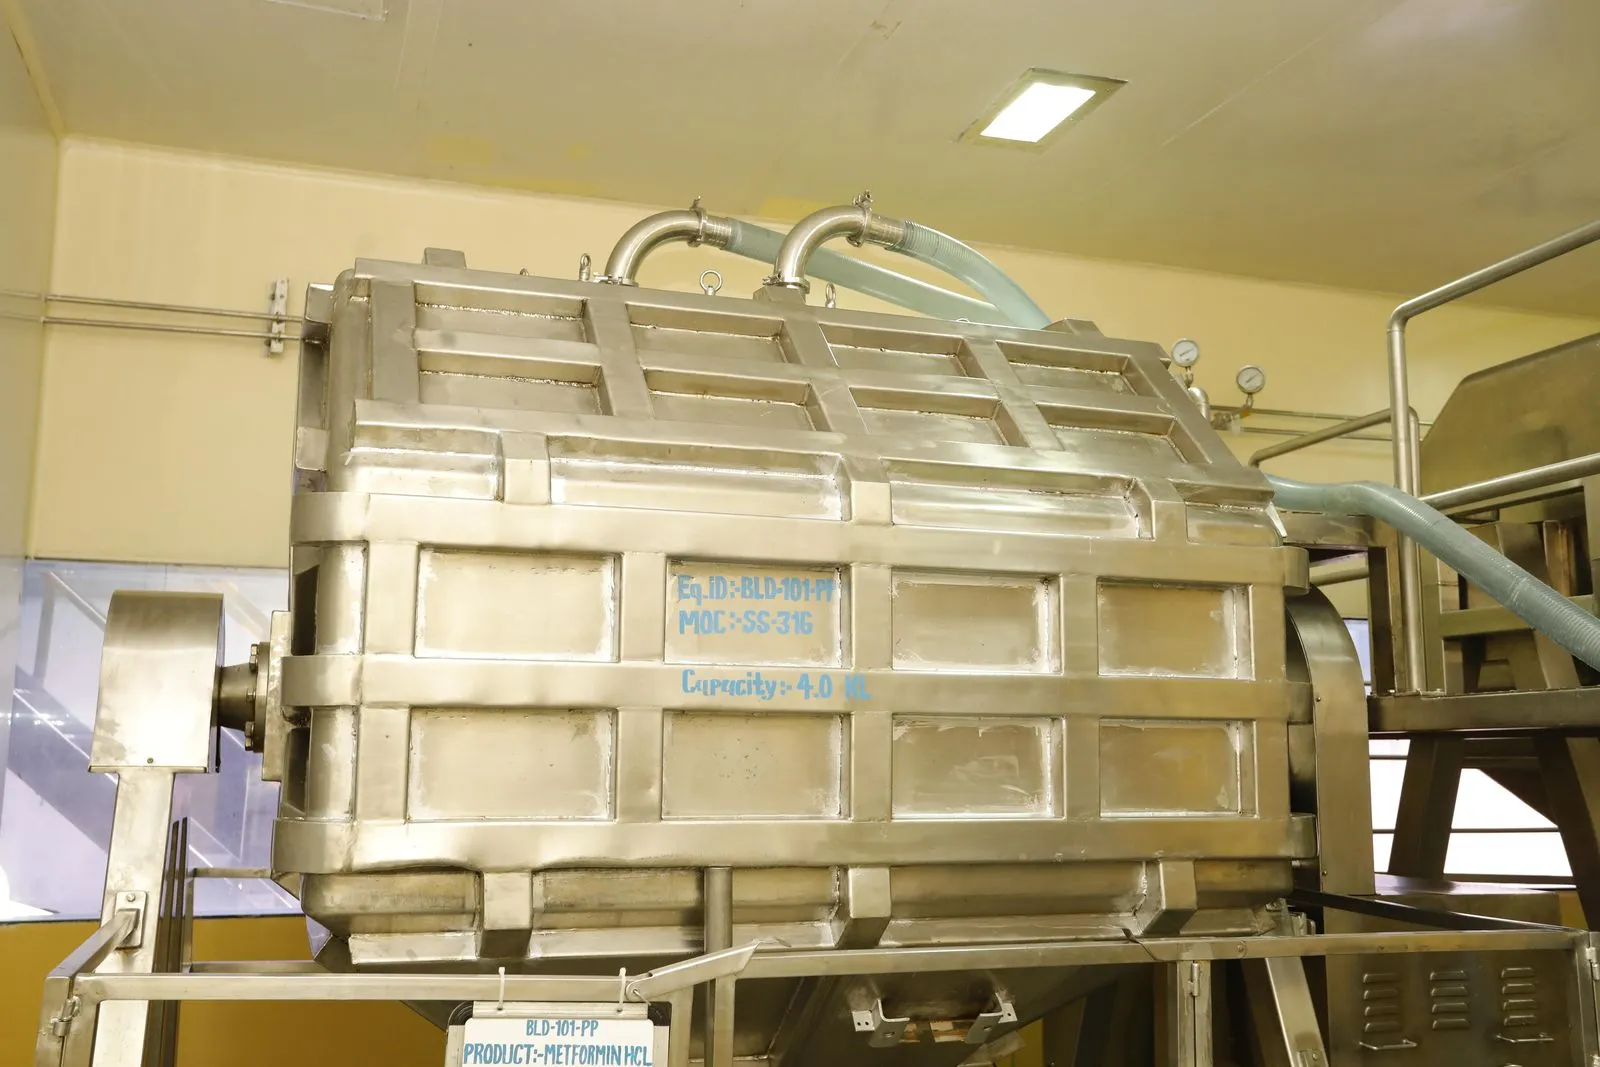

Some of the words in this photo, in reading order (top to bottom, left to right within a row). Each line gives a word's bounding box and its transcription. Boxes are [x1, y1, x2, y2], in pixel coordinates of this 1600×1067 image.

[796, 672, 833, 700] 4.0
[844, 674, 872, 700] KL
[525, 1019, 599, 1037] BLD-101-PP
[624, 1045, 652, 1066] HCL
